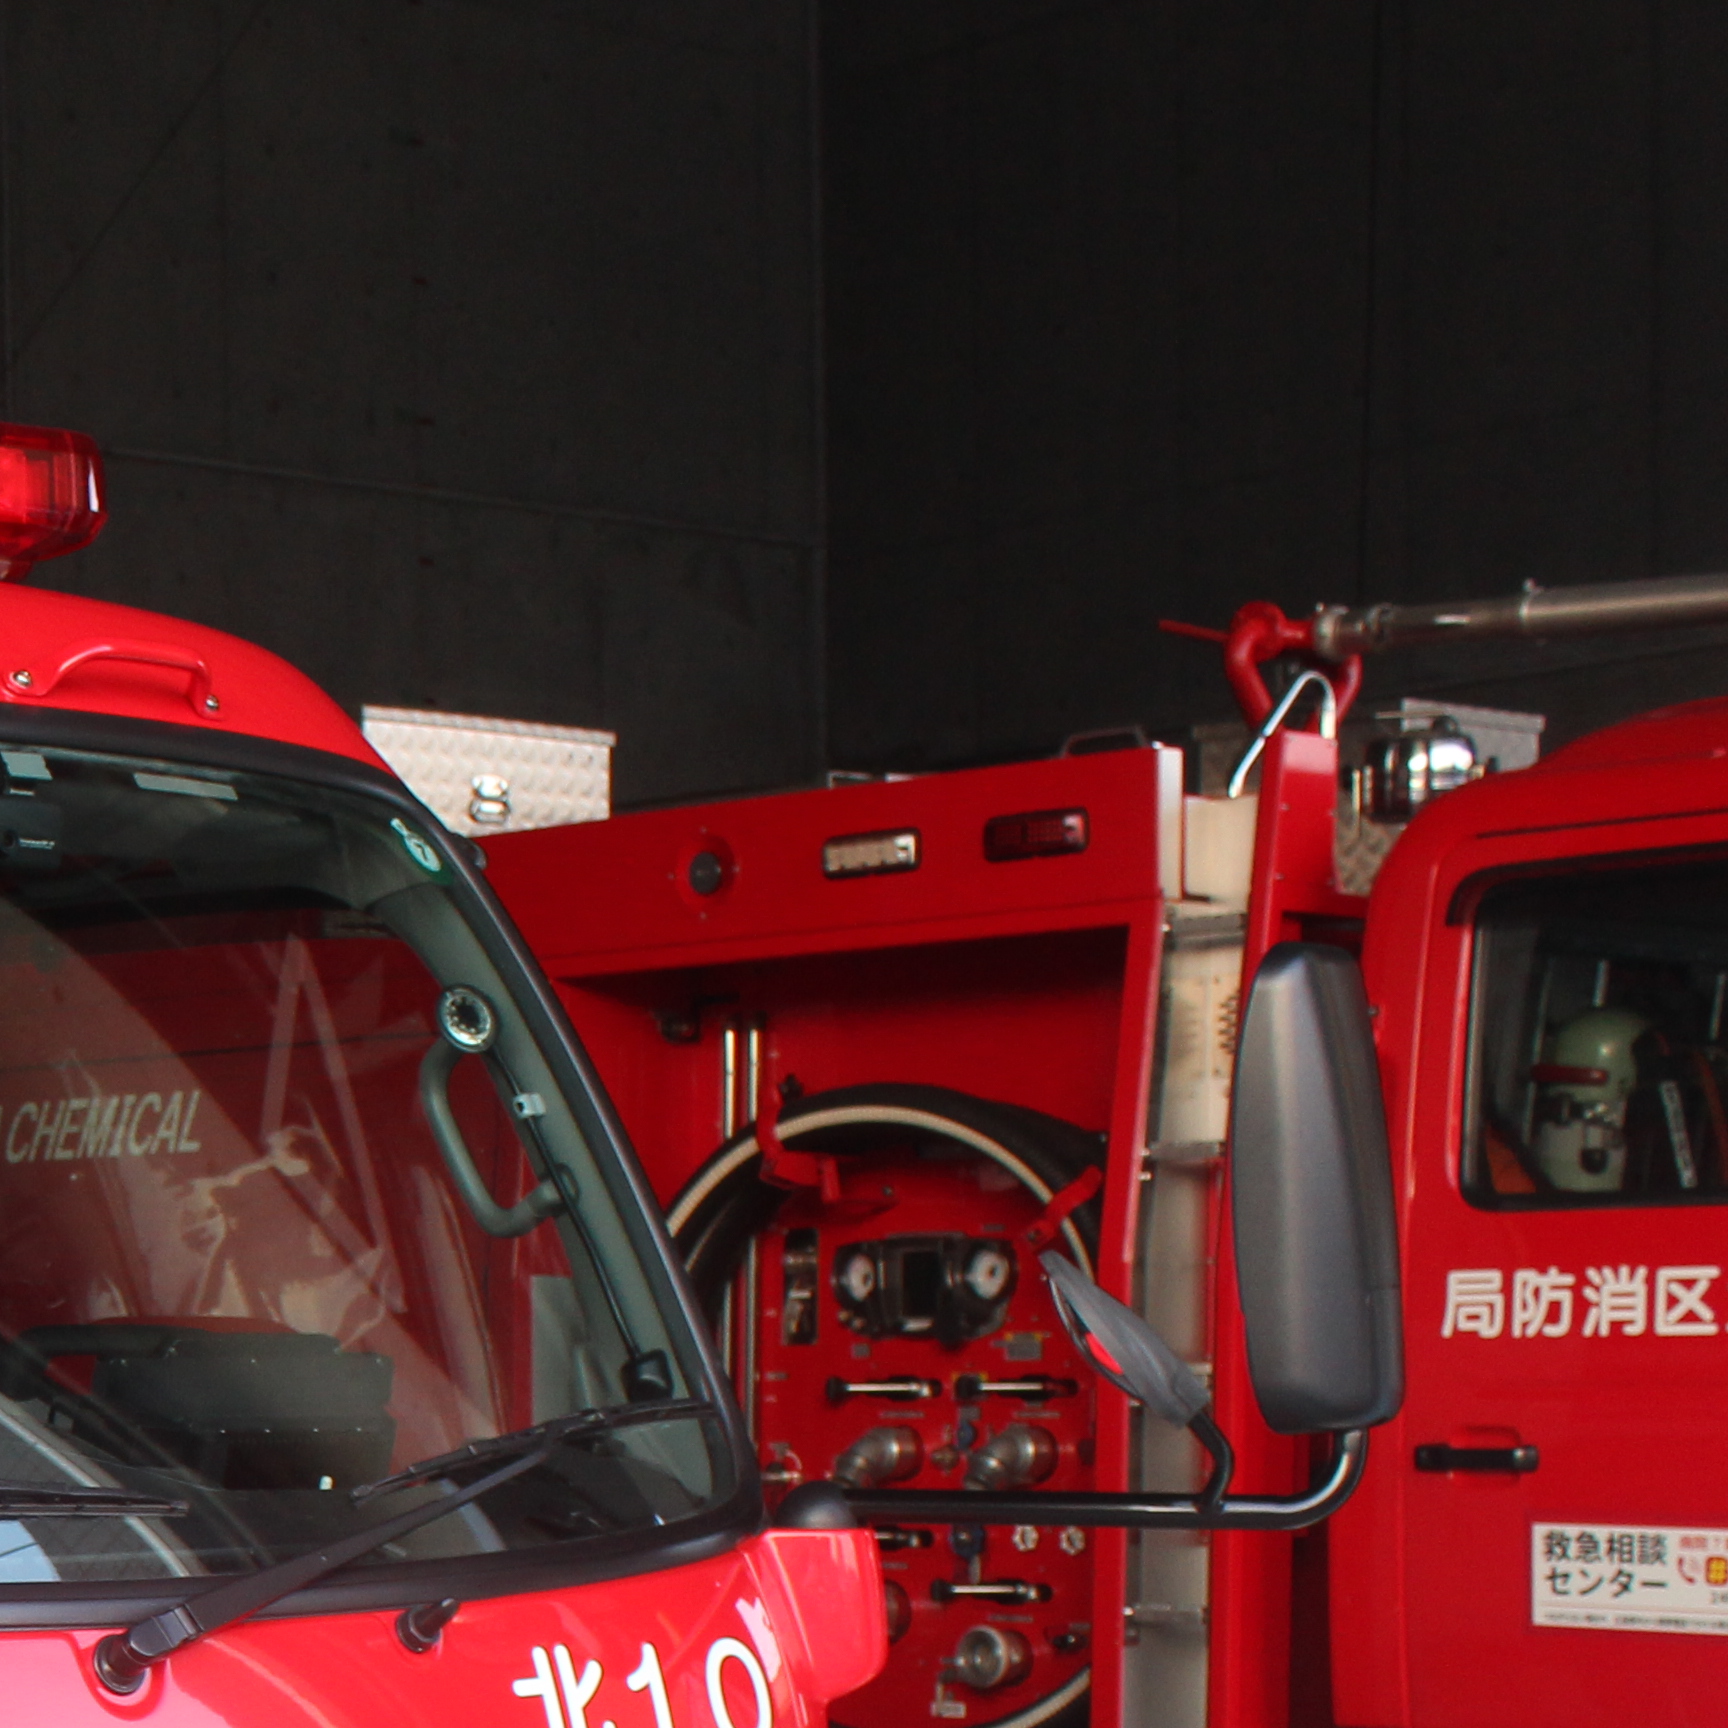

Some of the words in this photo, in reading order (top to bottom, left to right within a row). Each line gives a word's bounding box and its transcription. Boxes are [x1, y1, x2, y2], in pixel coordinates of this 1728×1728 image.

[7, 1090, 201, 1163] CHEMICAL
[1441, 1264, 1728, 1338] 局防消区
[1545, 1567, 1667, 1598] センター
